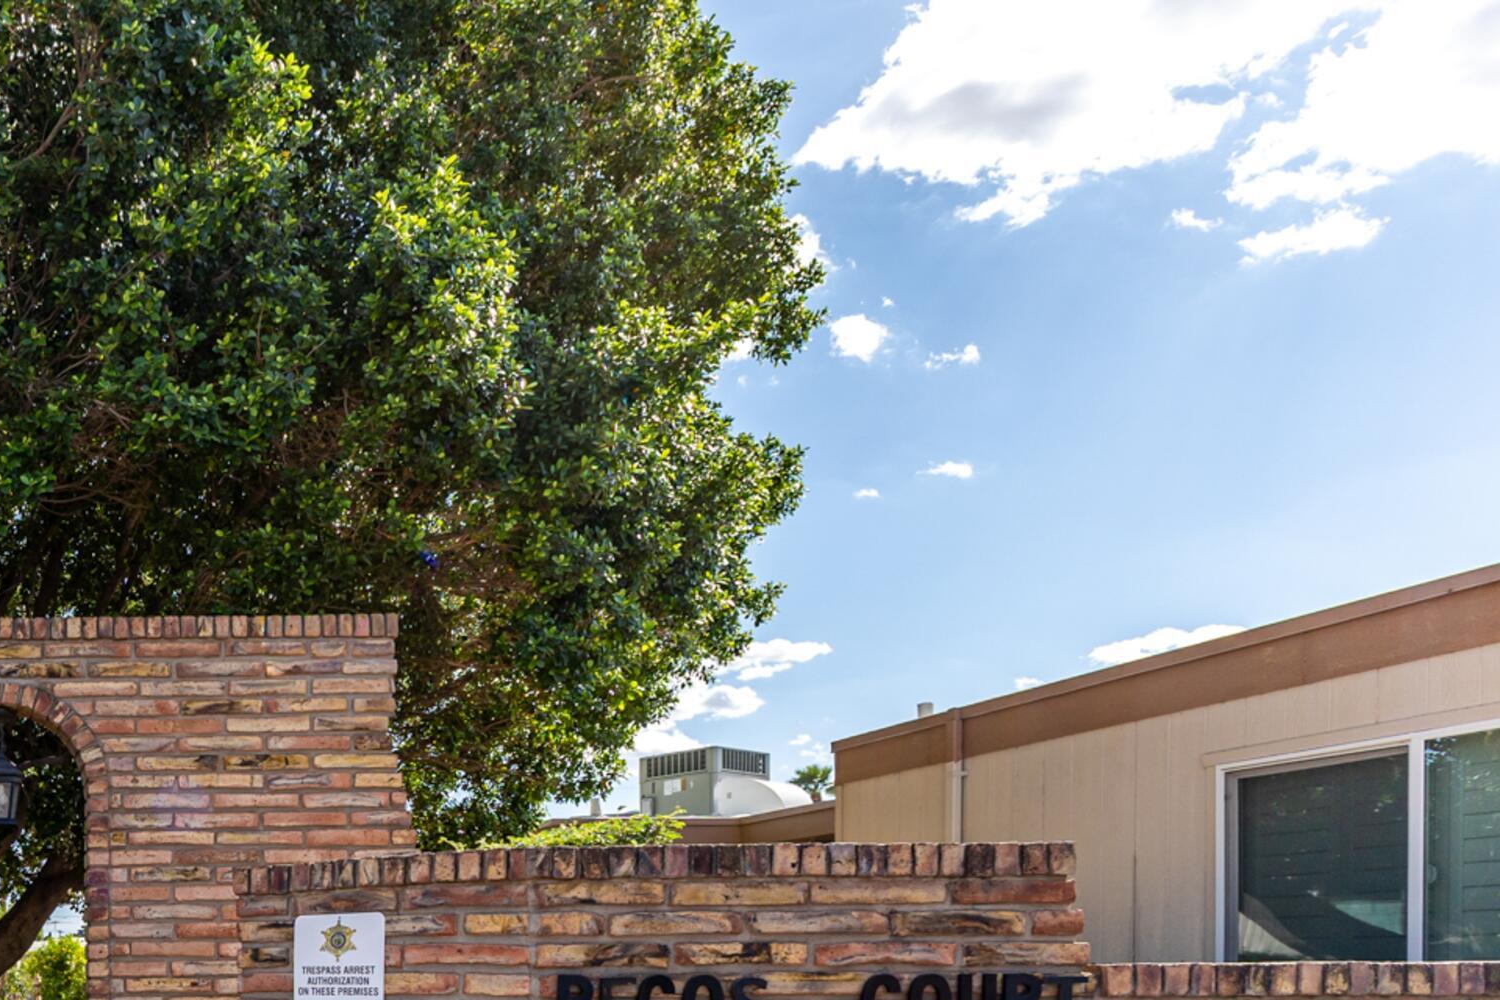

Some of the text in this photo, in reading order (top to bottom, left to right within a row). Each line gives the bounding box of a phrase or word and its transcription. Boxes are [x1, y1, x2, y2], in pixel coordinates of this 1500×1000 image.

[302, 965, 376, 975] TRESPASS ARREST
[307, 976, 370, 985] AUTHORIZATION
[298, 987, 379, 997] ON THESE PREMISES
